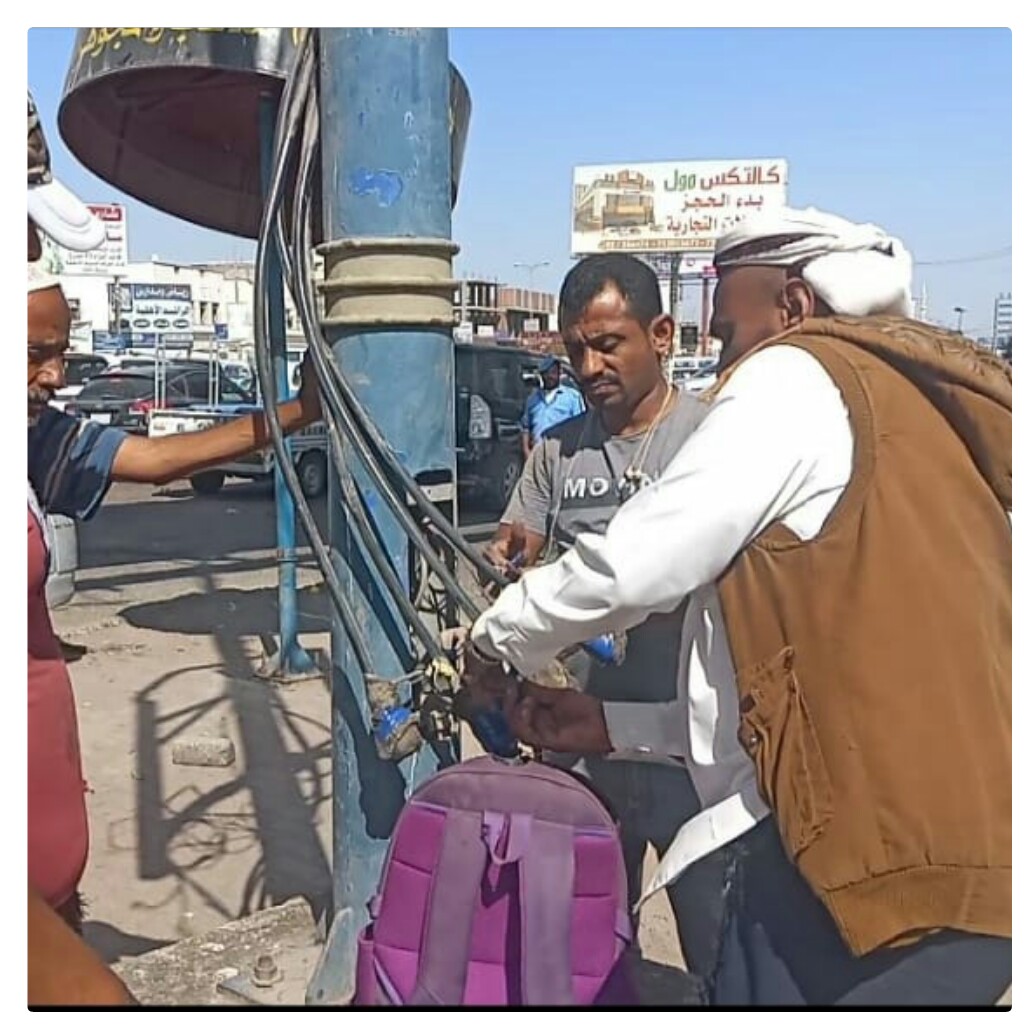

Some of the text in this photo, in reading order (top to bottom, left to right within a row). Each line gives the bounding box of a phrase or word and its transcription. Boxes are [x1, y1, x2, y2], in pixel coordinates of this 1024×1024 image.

[663, 165, 780, 192] كالتكس مول
[680, 192, 764, 213] بدء الحجز
[666, 215, 717, 235] التجارية
